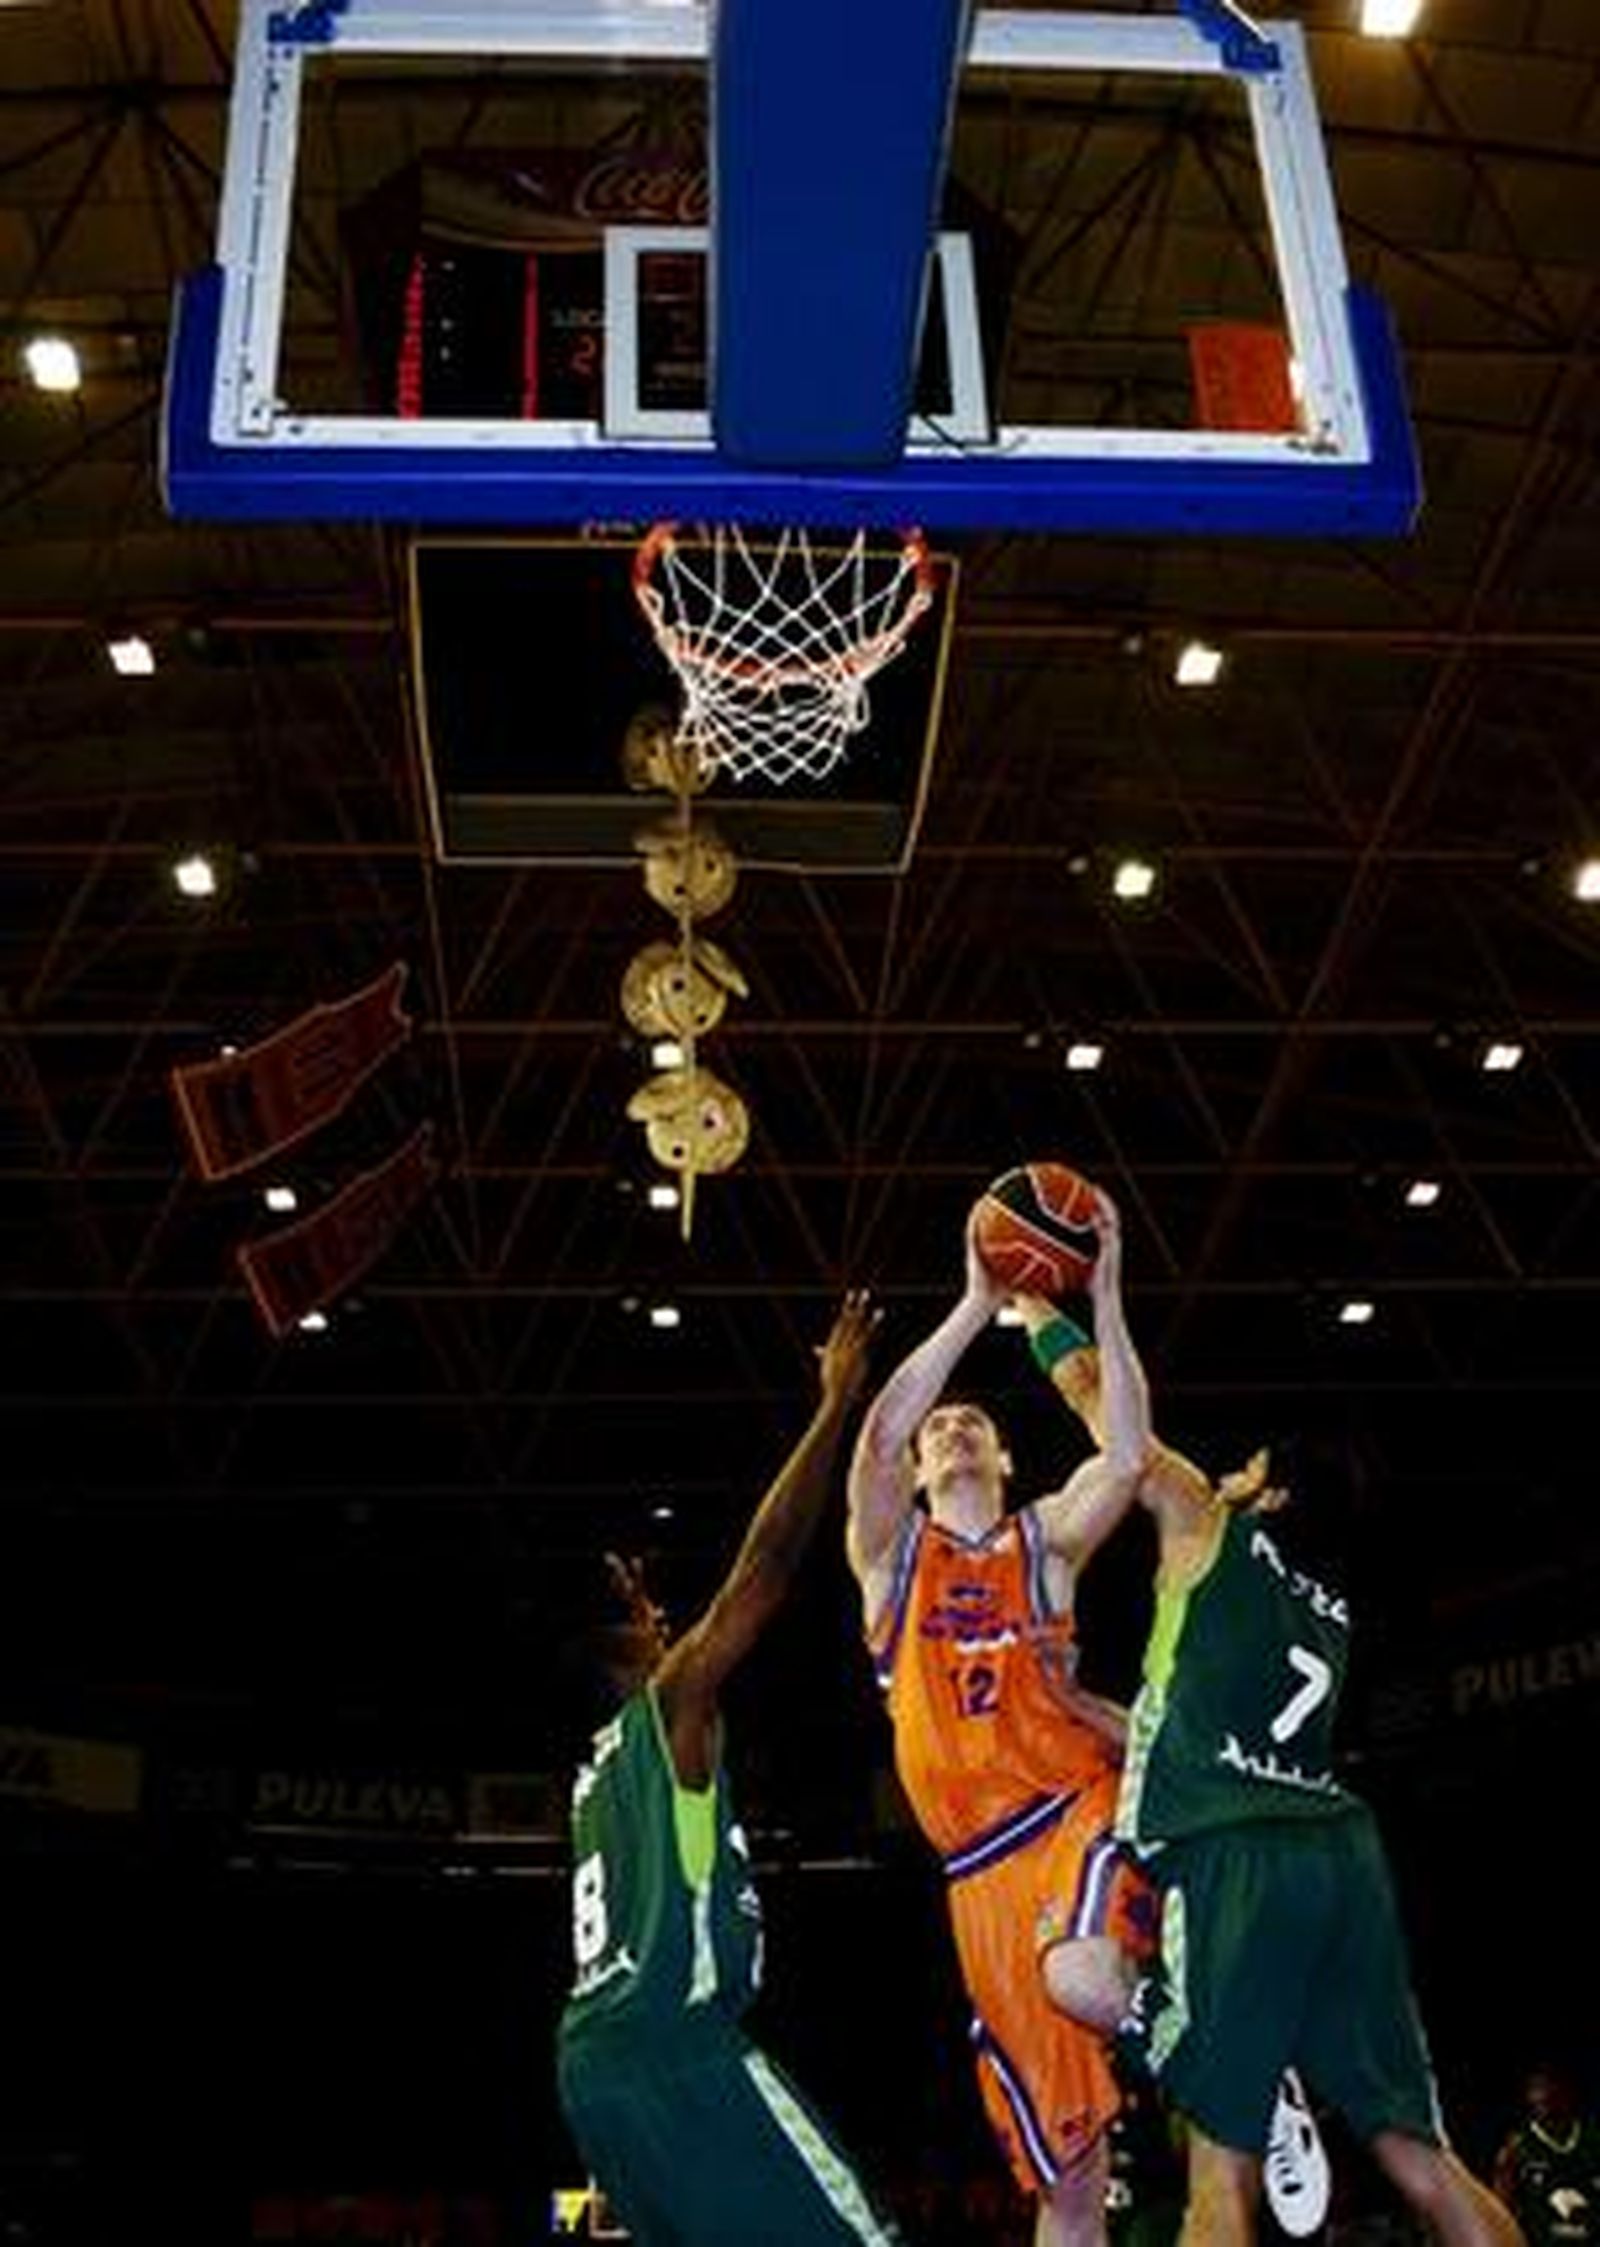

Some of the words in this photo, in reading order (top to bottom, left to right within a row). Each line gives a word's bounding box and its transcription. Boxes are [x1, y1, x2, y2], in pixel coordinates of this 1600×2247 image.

[950, 1663, 1001, 1719] 12
[1269, 1643, 1333, 1744] 7
[252, 1769, 454, 1821] PULEVA
